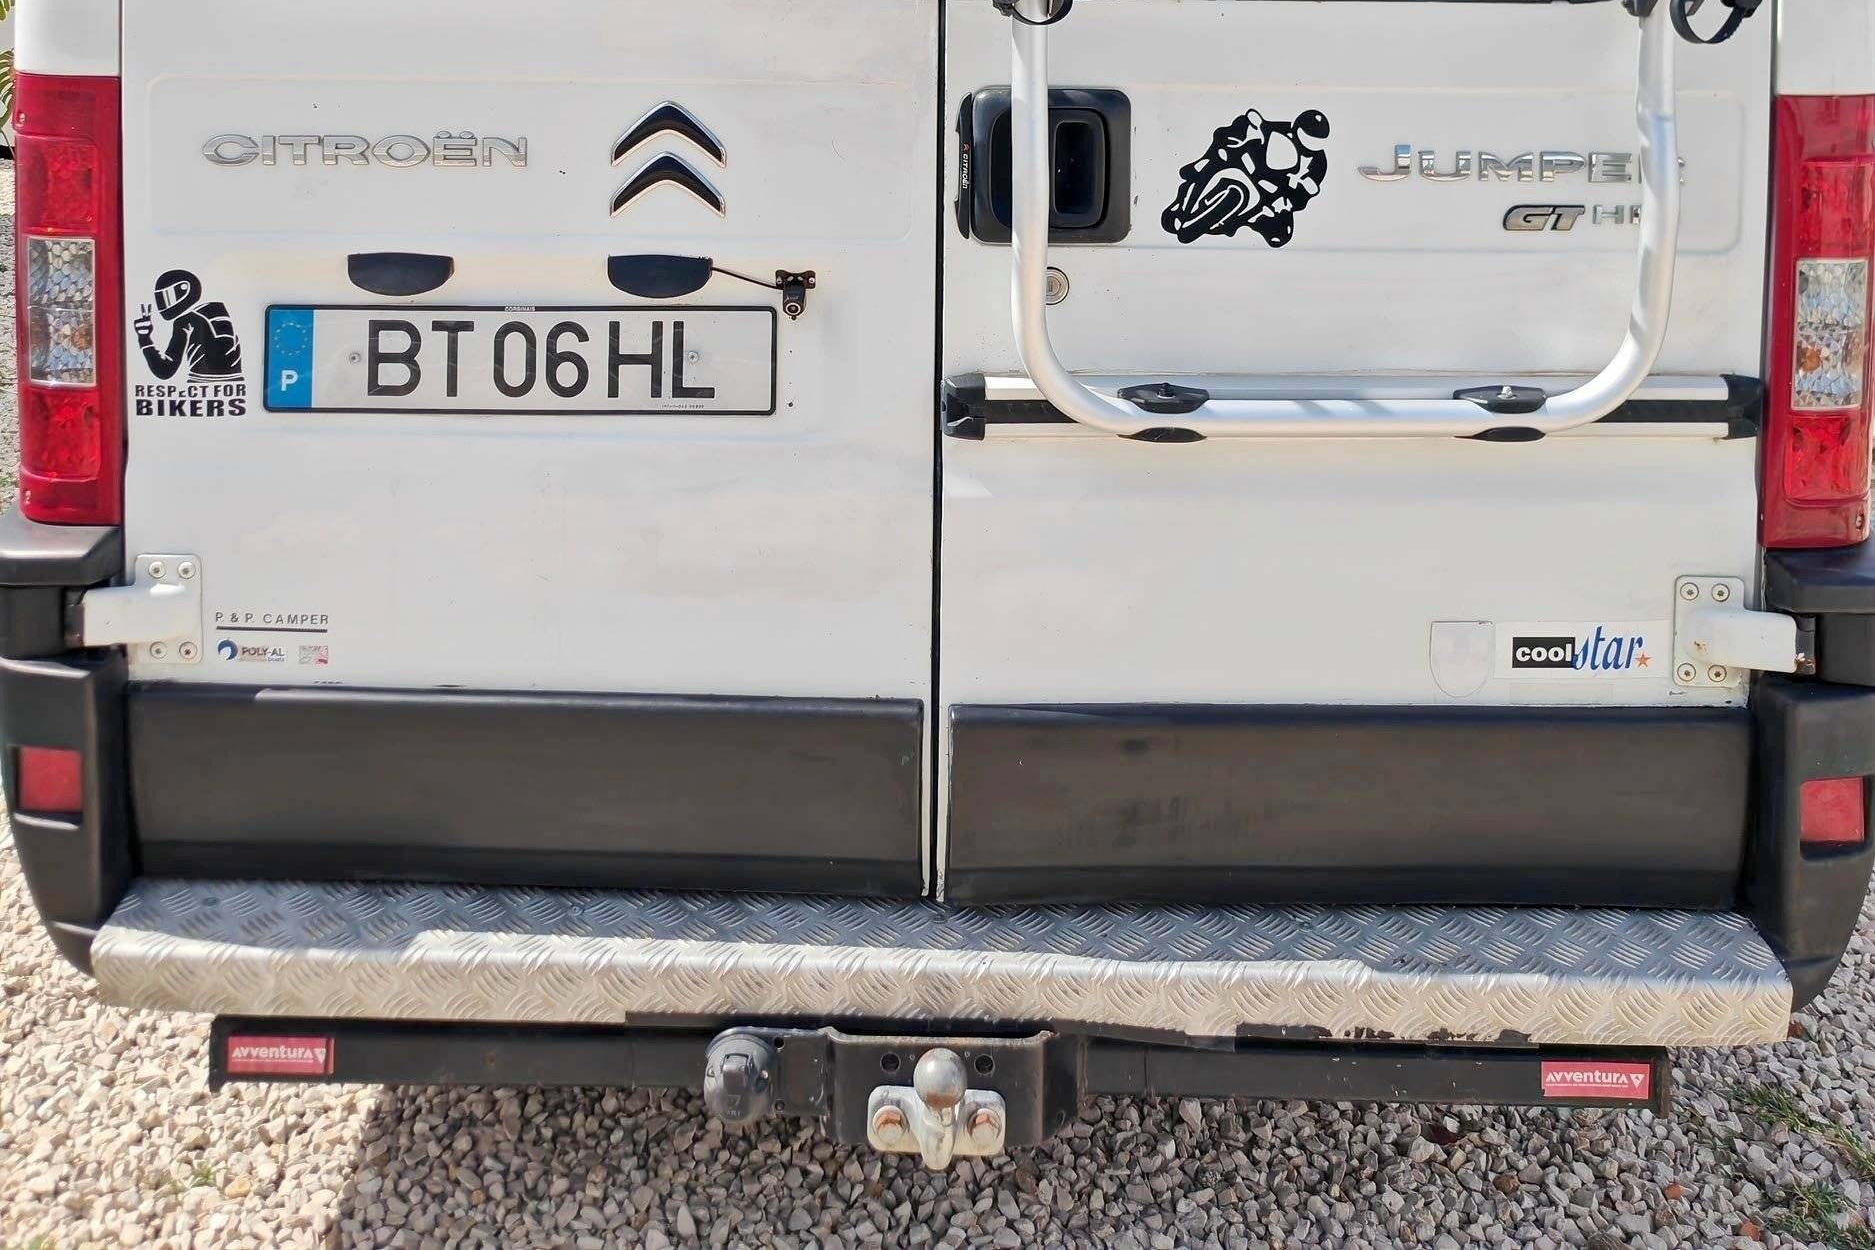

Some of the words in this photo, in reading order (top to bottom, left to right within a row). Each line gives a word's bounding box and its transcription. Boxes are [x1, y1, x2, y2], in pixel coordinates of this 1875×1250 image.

[201, 130, 528, 167] CITROËN
[1357, 144, 1686, 182] JUMPE
[1502, 204, 1586, 231] GT
[367, 319, 475, 398] BT
[493, 320, 590, 399] 06
[607, 320, 716, 399] HL
[213, 384, 246, 397] FOR
[280, 369, 299, 392] P
[135, 399, 246, 418] BIKERS
[230, 612, 239, 623] &
[263, 613, 329, 625] CAMPER
[241, 646, 285, 657] POLY-AL
